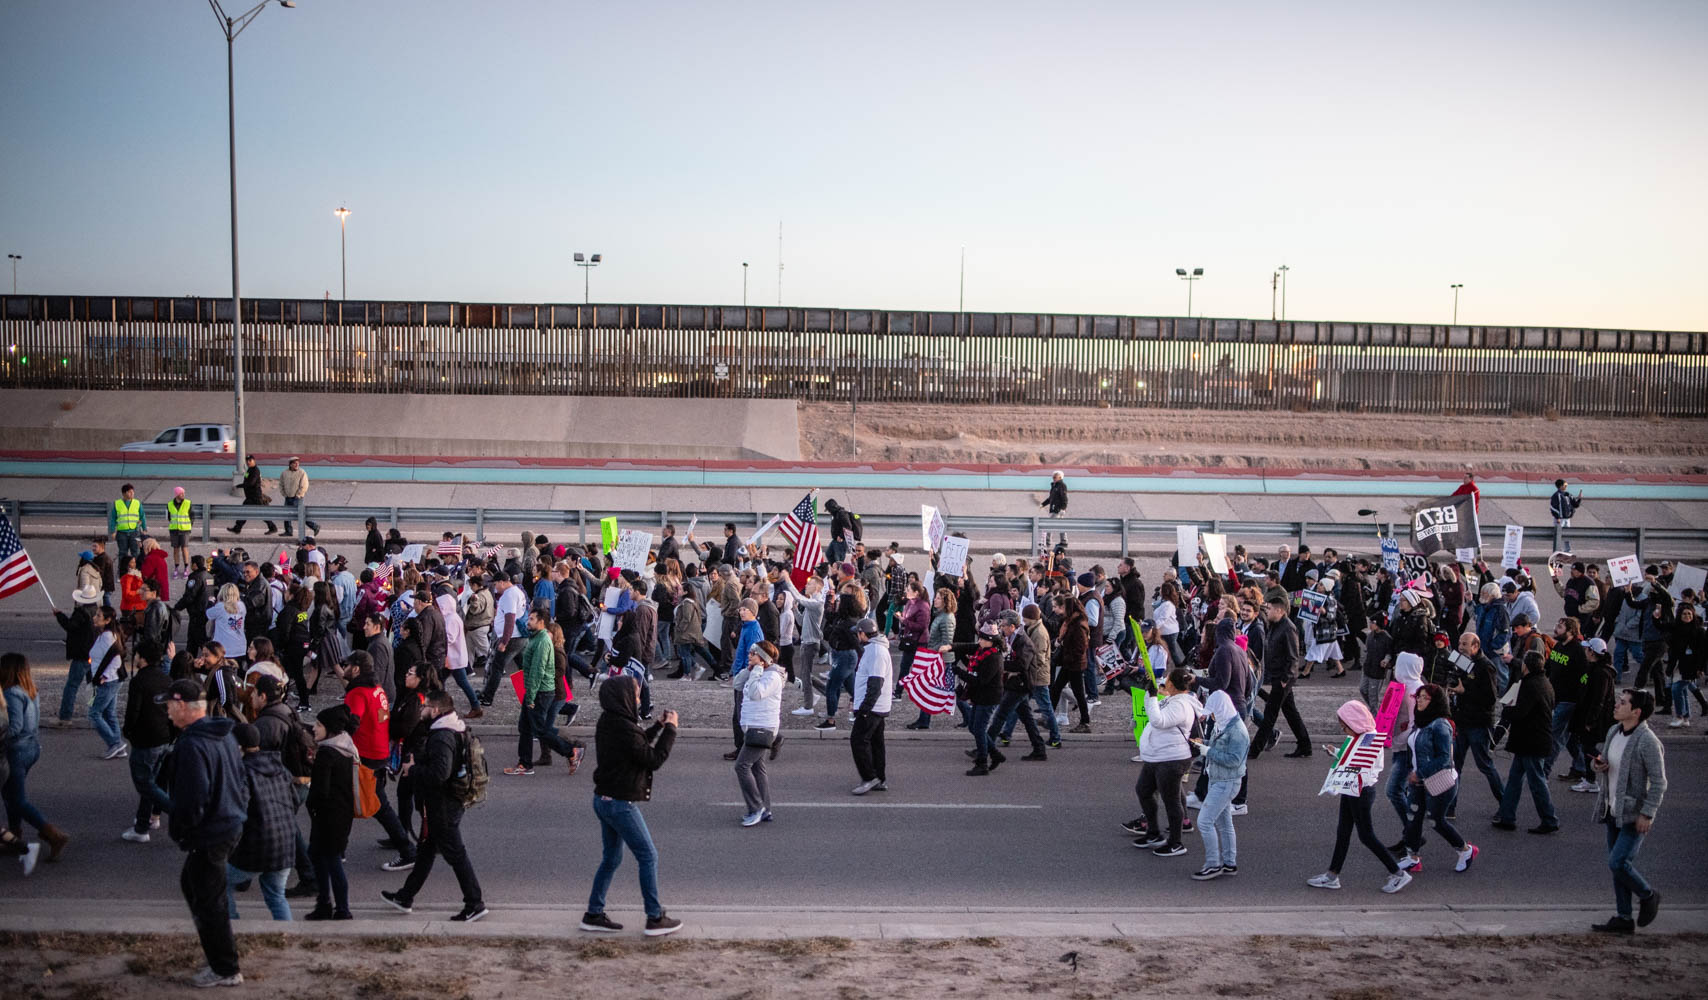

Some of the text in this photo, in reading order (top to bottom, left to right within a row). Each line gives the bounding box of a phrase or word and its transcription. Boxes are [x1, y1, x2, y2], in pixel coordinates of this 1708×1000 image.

[943, 541, 967, 561] BETO
[941, 560, 960, 573] 2020
[1404, 554, 1427, 569] TO
